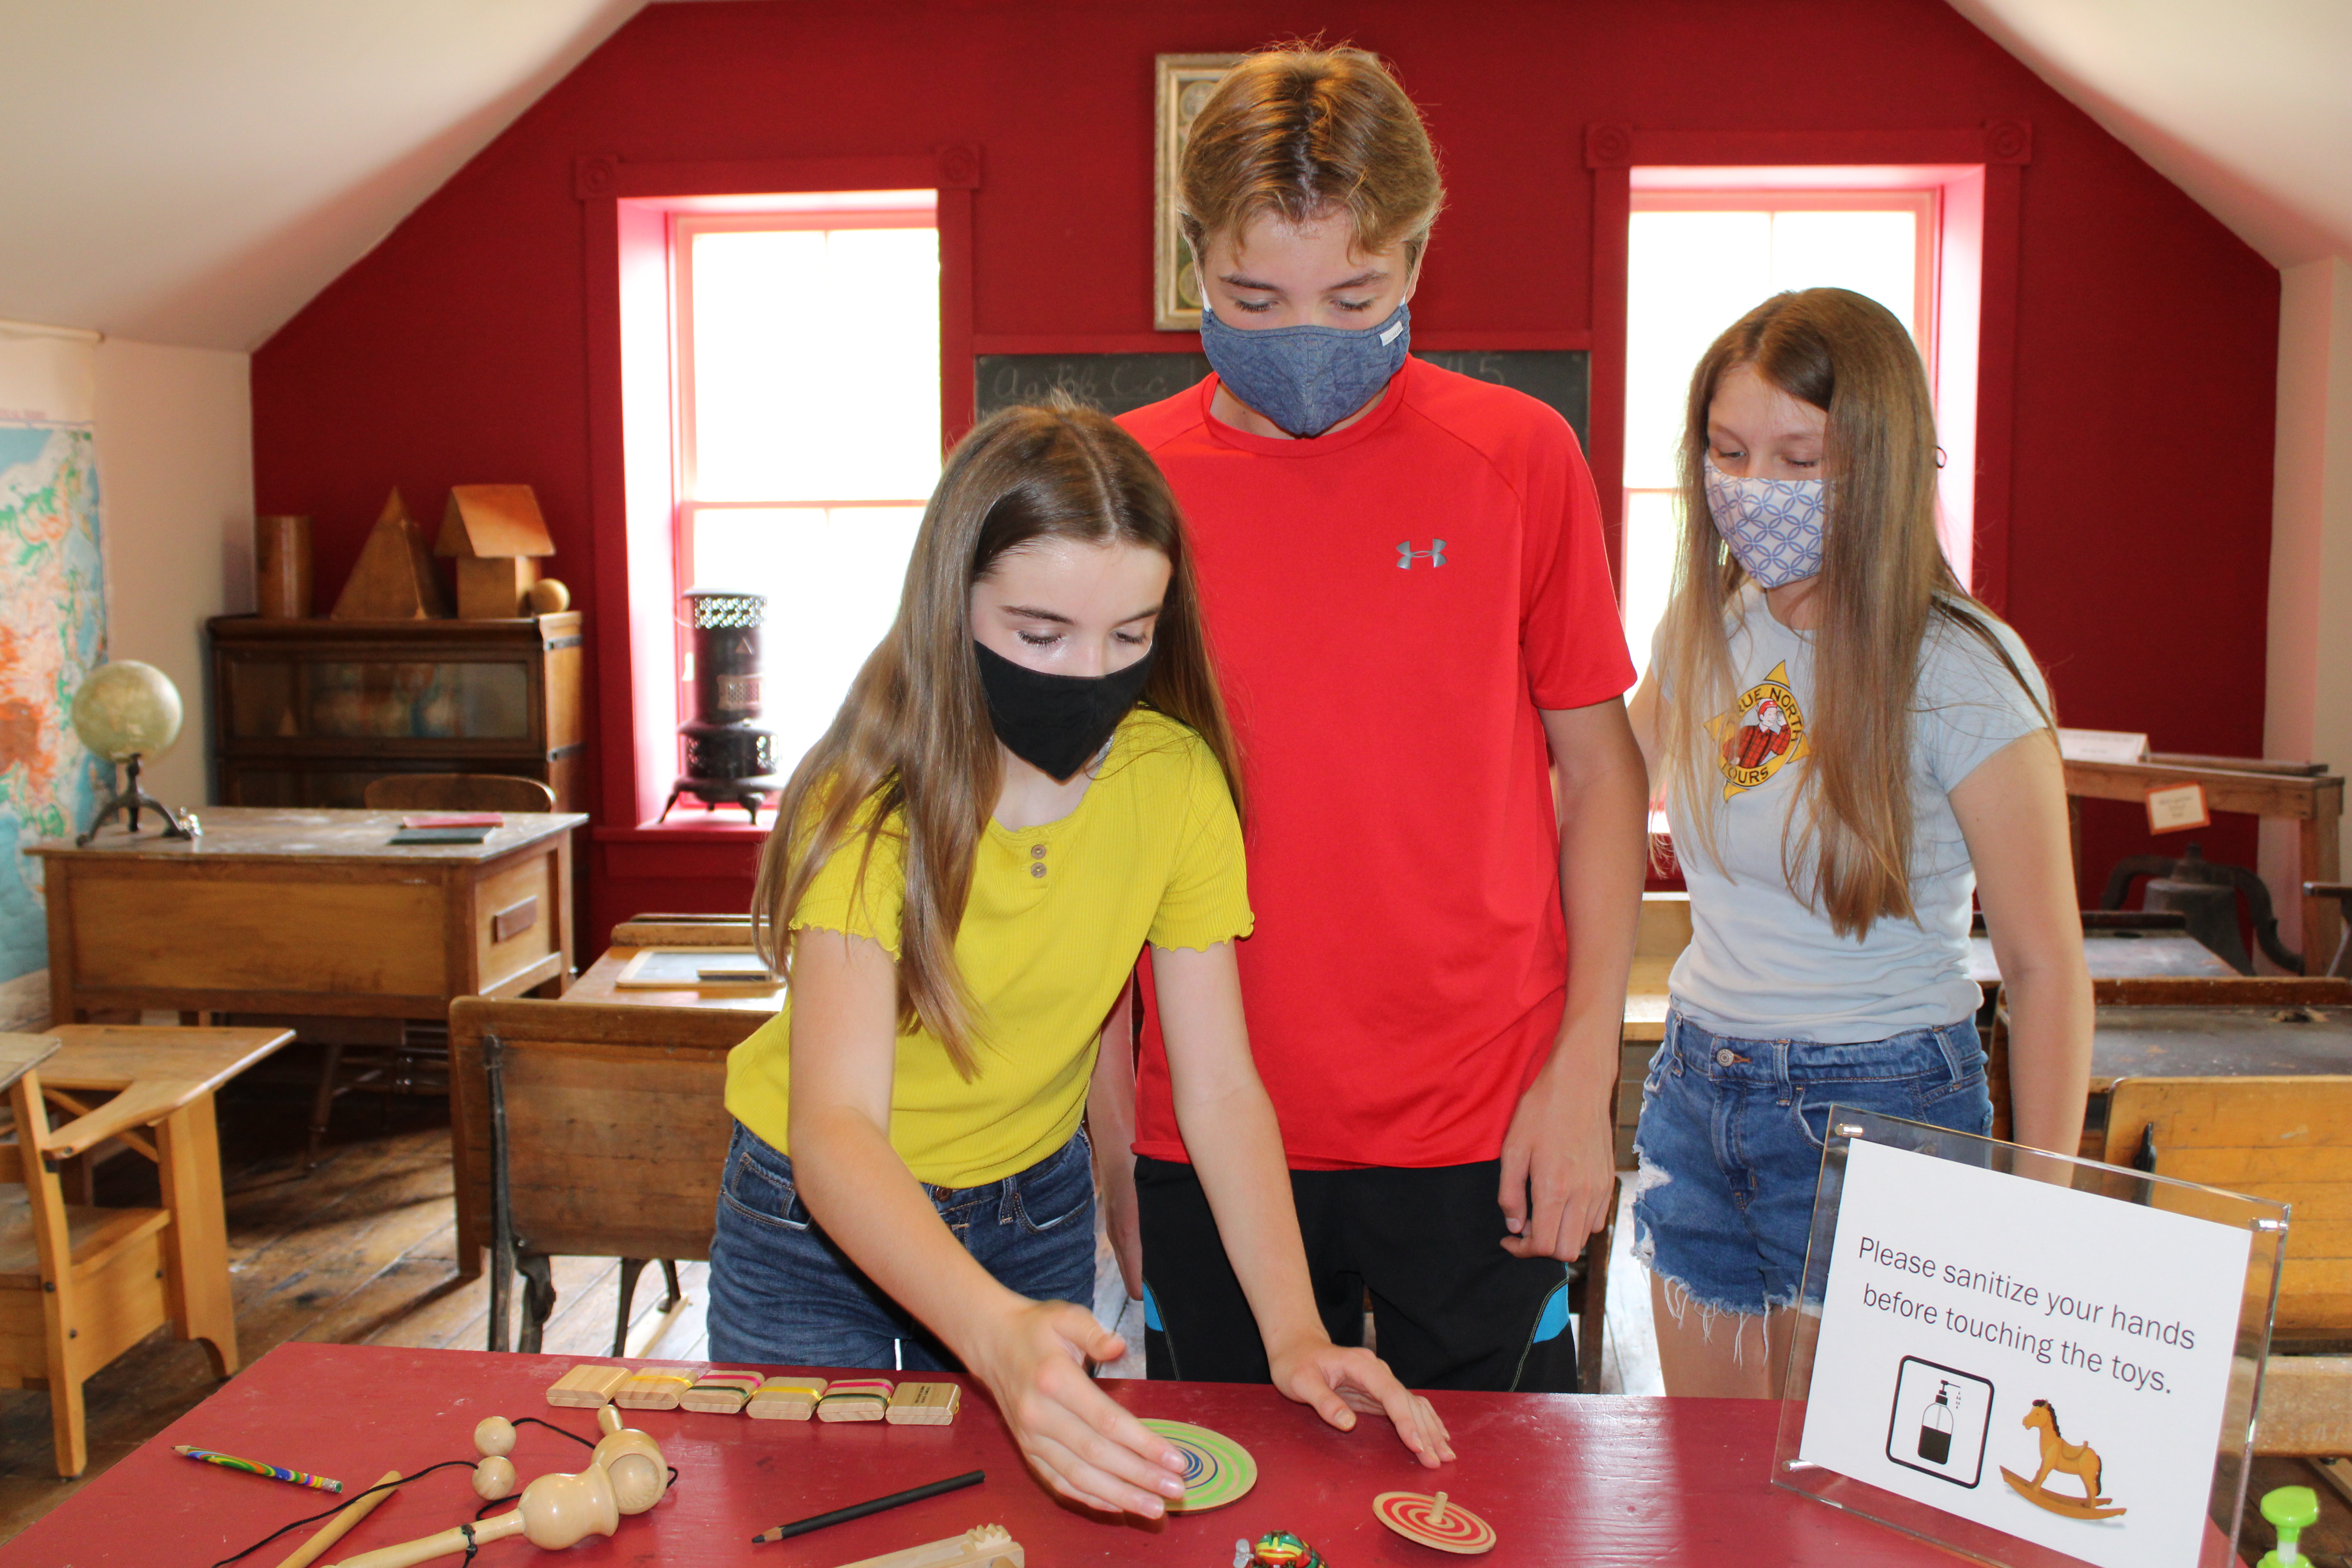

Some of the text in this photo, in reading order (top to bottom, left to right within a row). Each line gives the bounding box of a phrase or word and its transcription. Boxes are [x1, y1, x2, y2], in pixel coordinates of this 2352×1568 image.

[1770, 688, 1802, 742] NORTH
[1859, 1236, 2195, 1349] Please sanitize your hands
[1863, 1283, 2171, 1394] before touching the toys.
